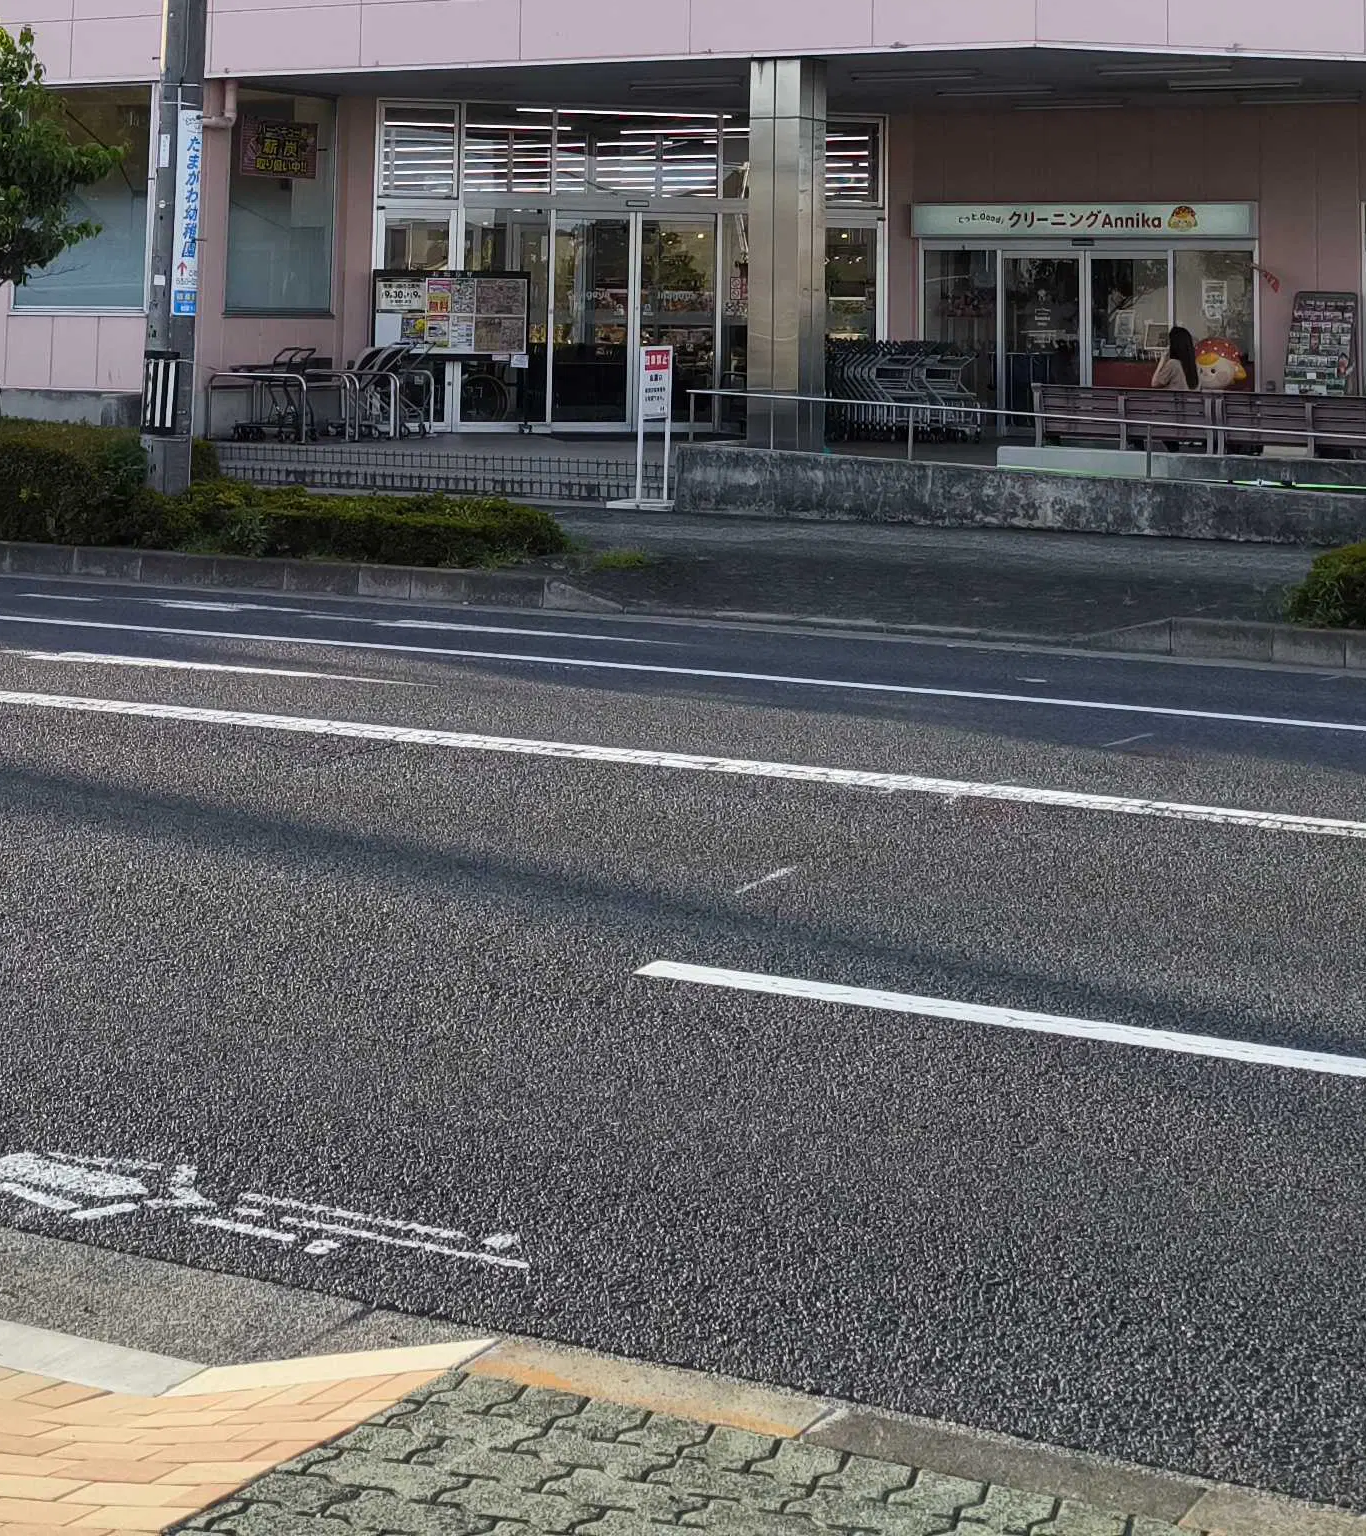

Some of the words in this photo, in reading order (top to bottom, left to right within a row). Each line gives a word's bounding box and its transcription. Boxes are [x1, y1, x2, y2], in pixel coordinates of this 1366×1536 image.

[181, 135, 201, 258] たまがわ幼稚園
